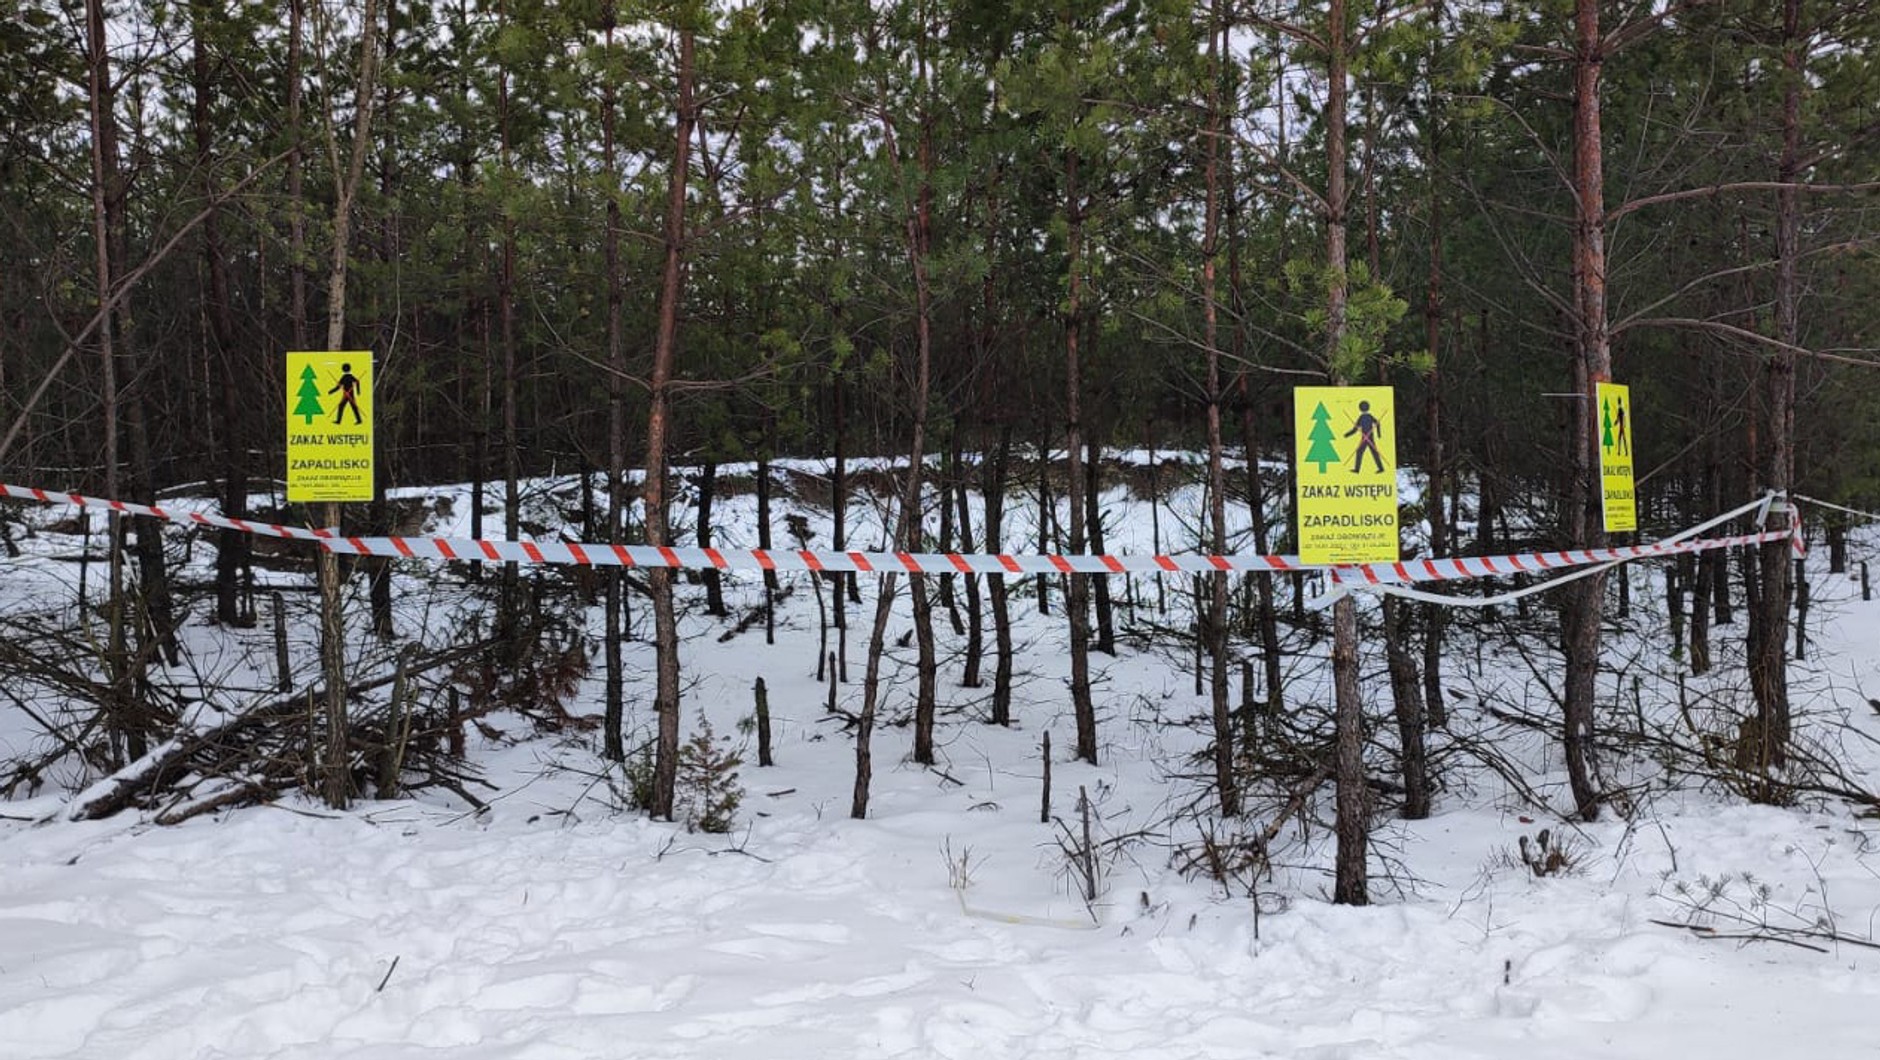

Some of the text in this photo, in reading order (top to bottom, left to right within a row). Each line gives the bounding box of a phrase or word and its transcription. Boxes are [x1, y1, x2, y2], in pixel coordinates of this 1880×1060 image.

[290, 434, 368, 448] ZAKAZ WSTĘPU
[291, 459, 369, 469] ZAPADLISKO
[1302, 484, 1393, 500] ZAKAZ WSTĘPU
[1303, 514, 1394, 527] ZAPADLISKO
